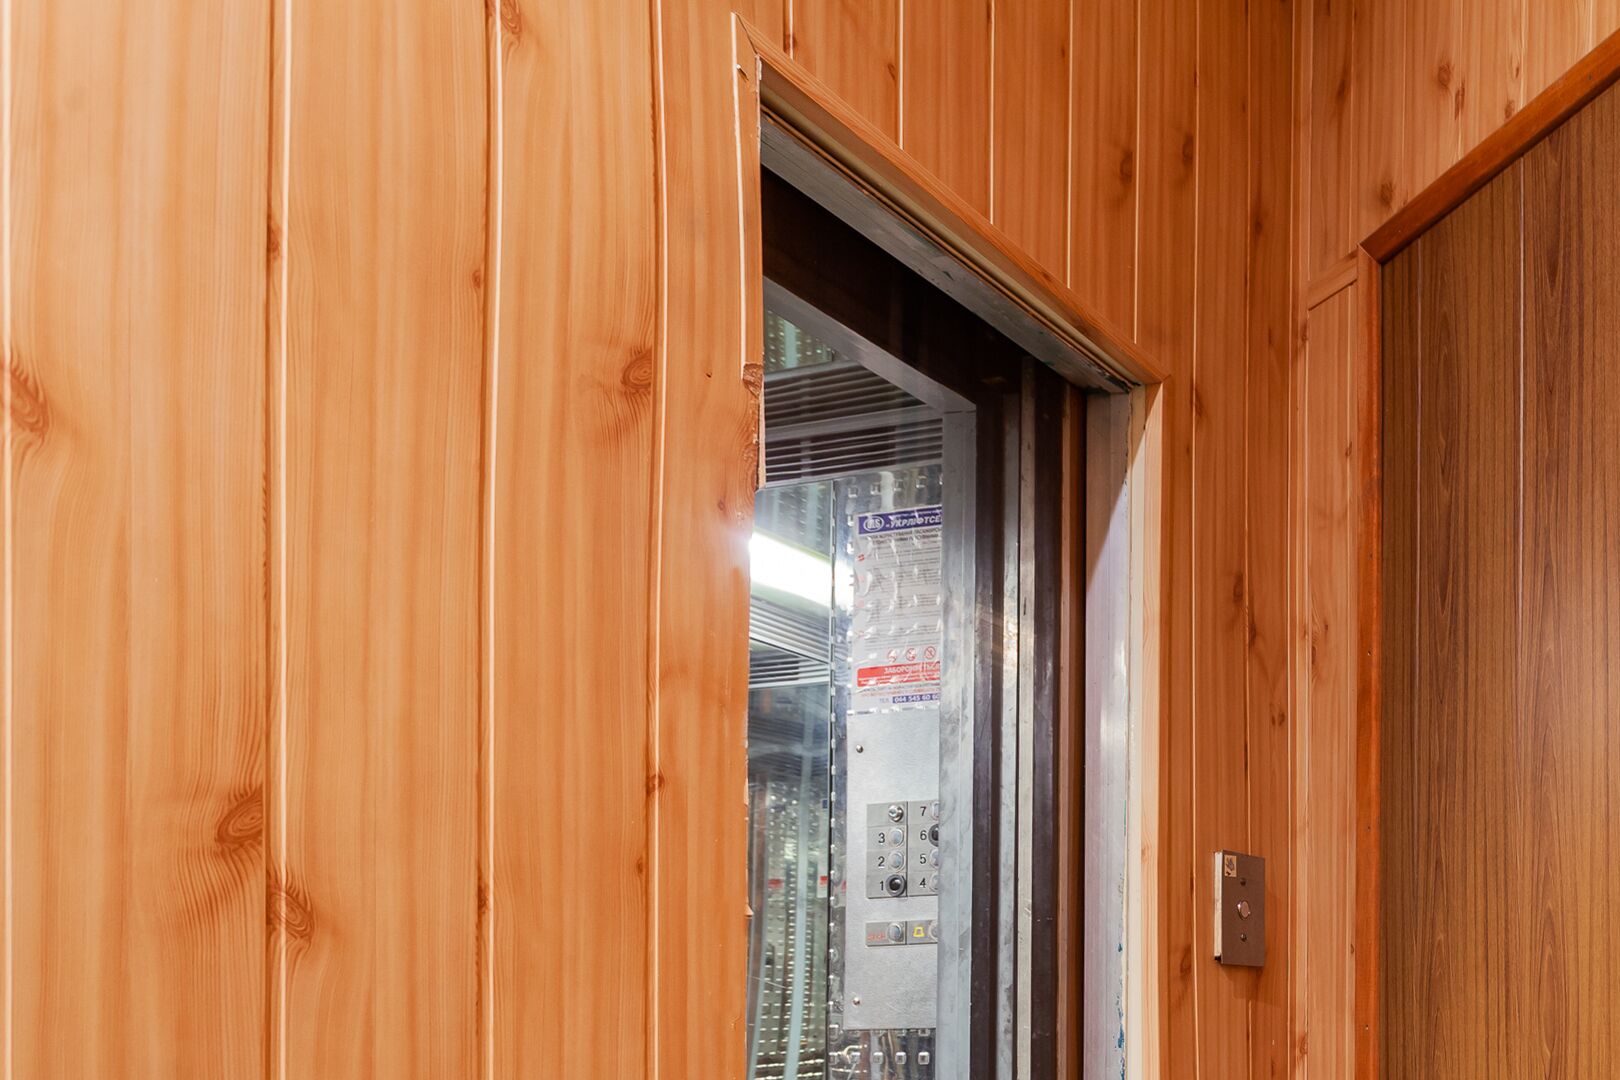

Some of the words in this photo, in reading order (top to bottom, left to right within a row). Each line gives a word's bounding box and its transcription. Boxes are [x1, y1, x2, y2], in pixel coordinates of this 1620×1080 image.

[920, 806, 927, 816] 7
[878, 832, 885, 843] 3
[920, 830, 927, 840] 6
[878, 856, 885, 867] 2
[920, 854, 927, 864] 5
[919, 877, 926, 888] 4
